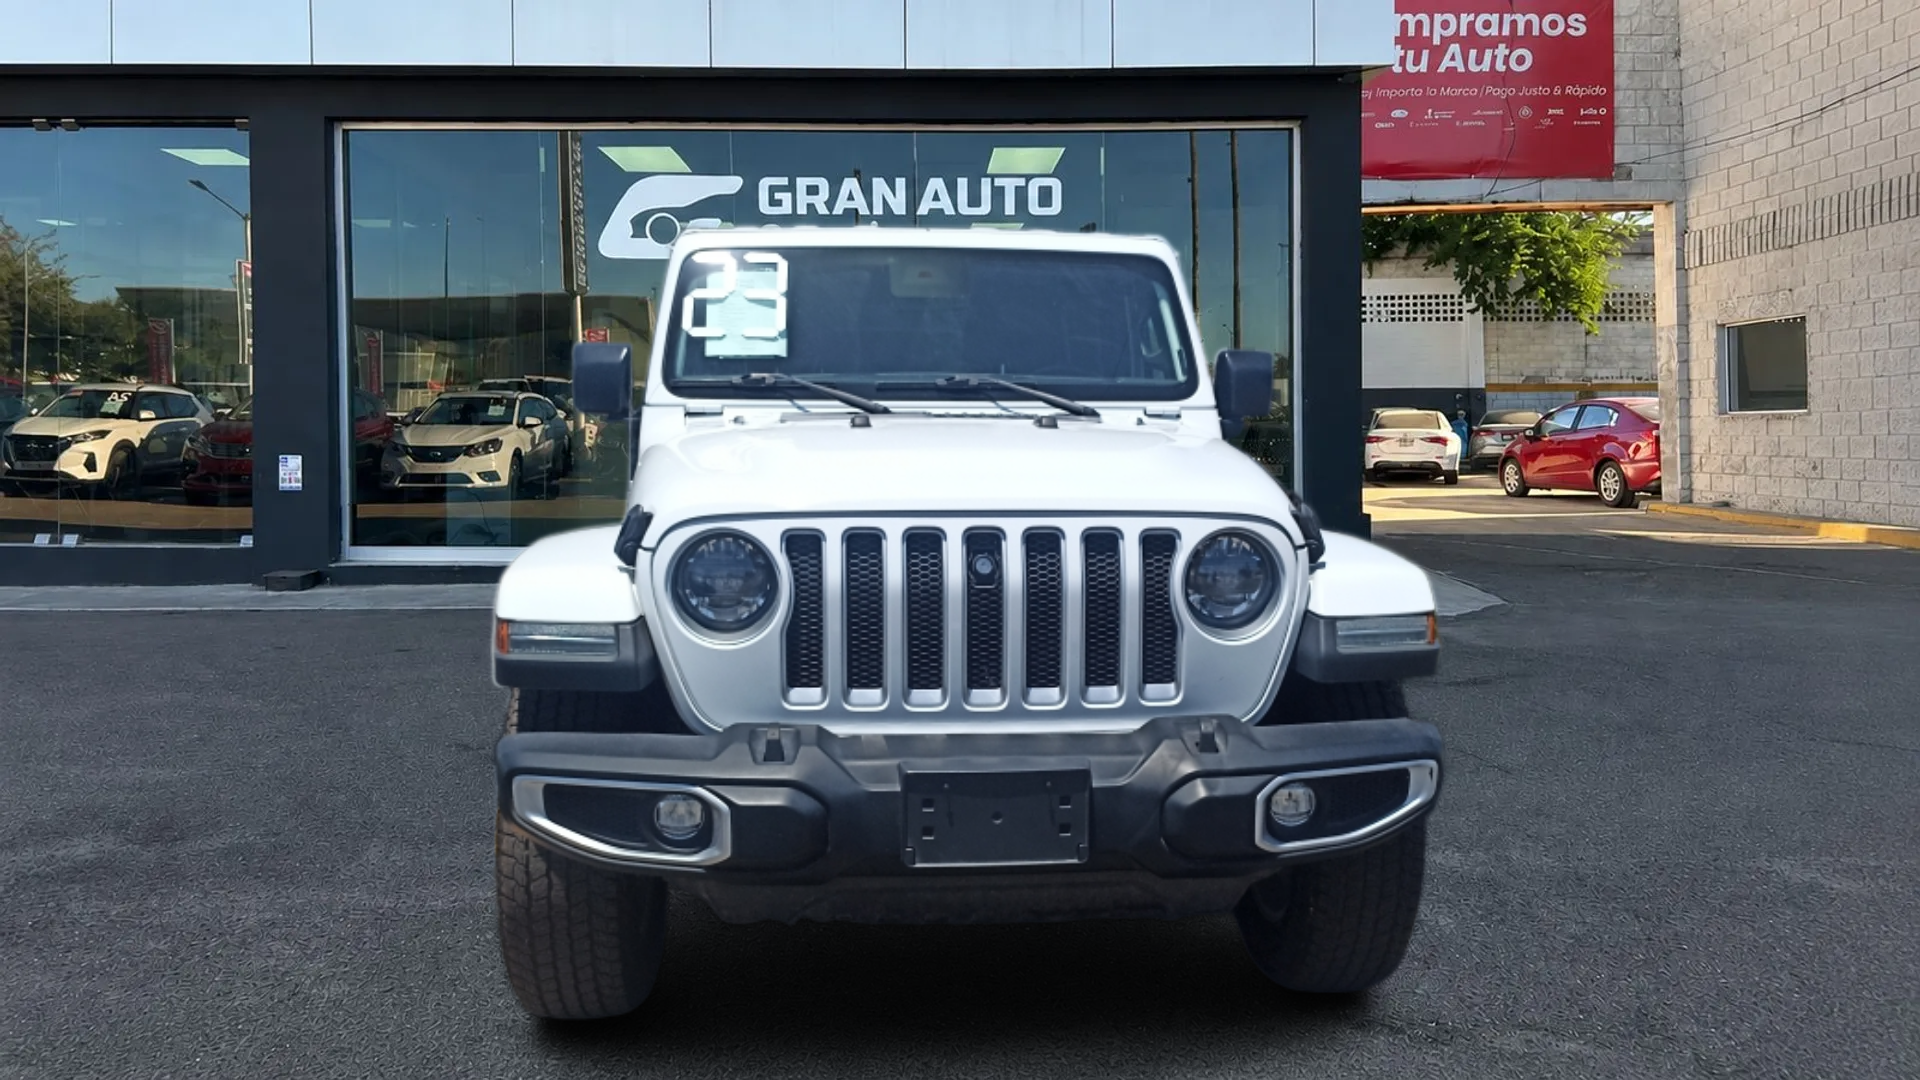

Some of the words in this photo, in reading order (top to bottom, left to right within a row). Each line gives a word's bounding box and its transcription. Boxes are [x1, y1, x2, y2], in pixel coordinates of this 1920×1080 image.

[1437, 43, 1534, 73] Auto
[1440, 86, 1478, 96] Marca
[1518, 86, 1551, 96] Justo
[1553, 86, 1562, 96] &
[758, 176, 907, 215] GRAN
[916, 176, 1063, 215] AUTO
[682, 251, 788, 337] 23
